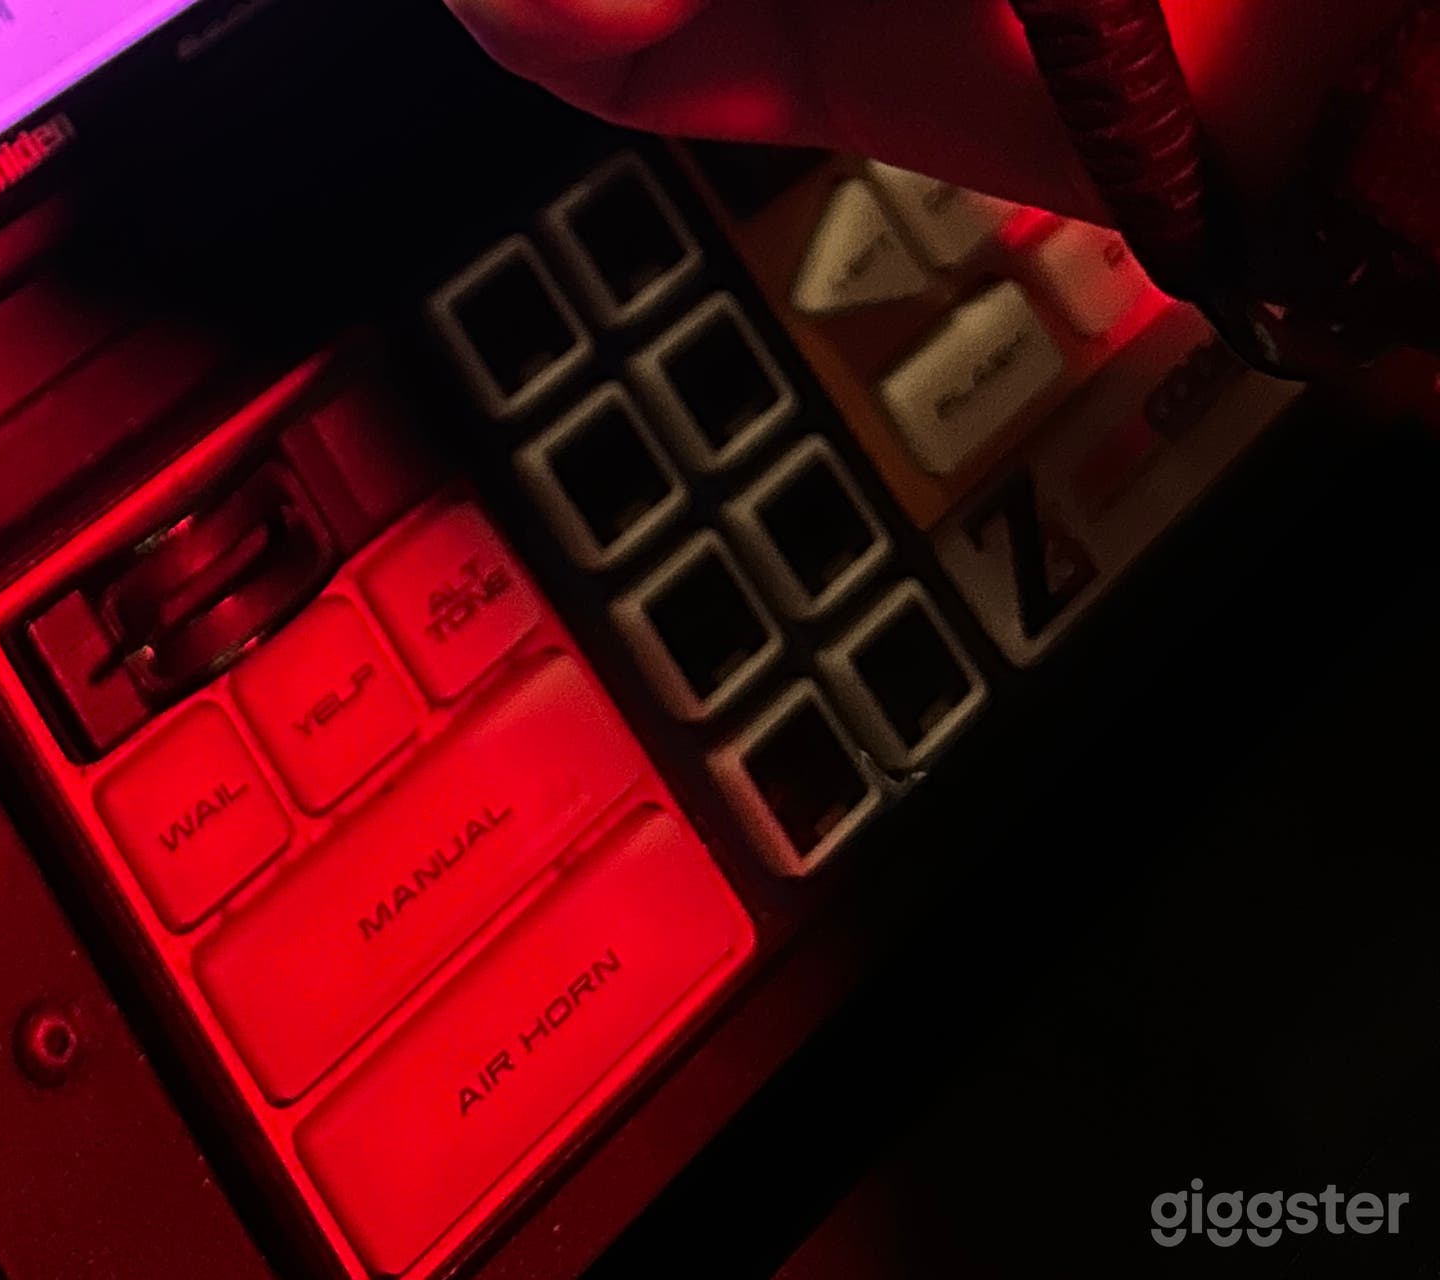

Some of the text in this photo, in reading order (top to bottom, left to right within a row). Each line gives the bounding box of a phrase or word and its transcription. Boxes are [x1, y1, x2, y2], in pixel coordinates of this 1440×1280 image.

[292, 662, 375, 738] YELP
[159, 778, 251, 851] WAIL
[358, 802, 515, 941] MANUAL
[457, 951, 622, 1118] AIR HORN
